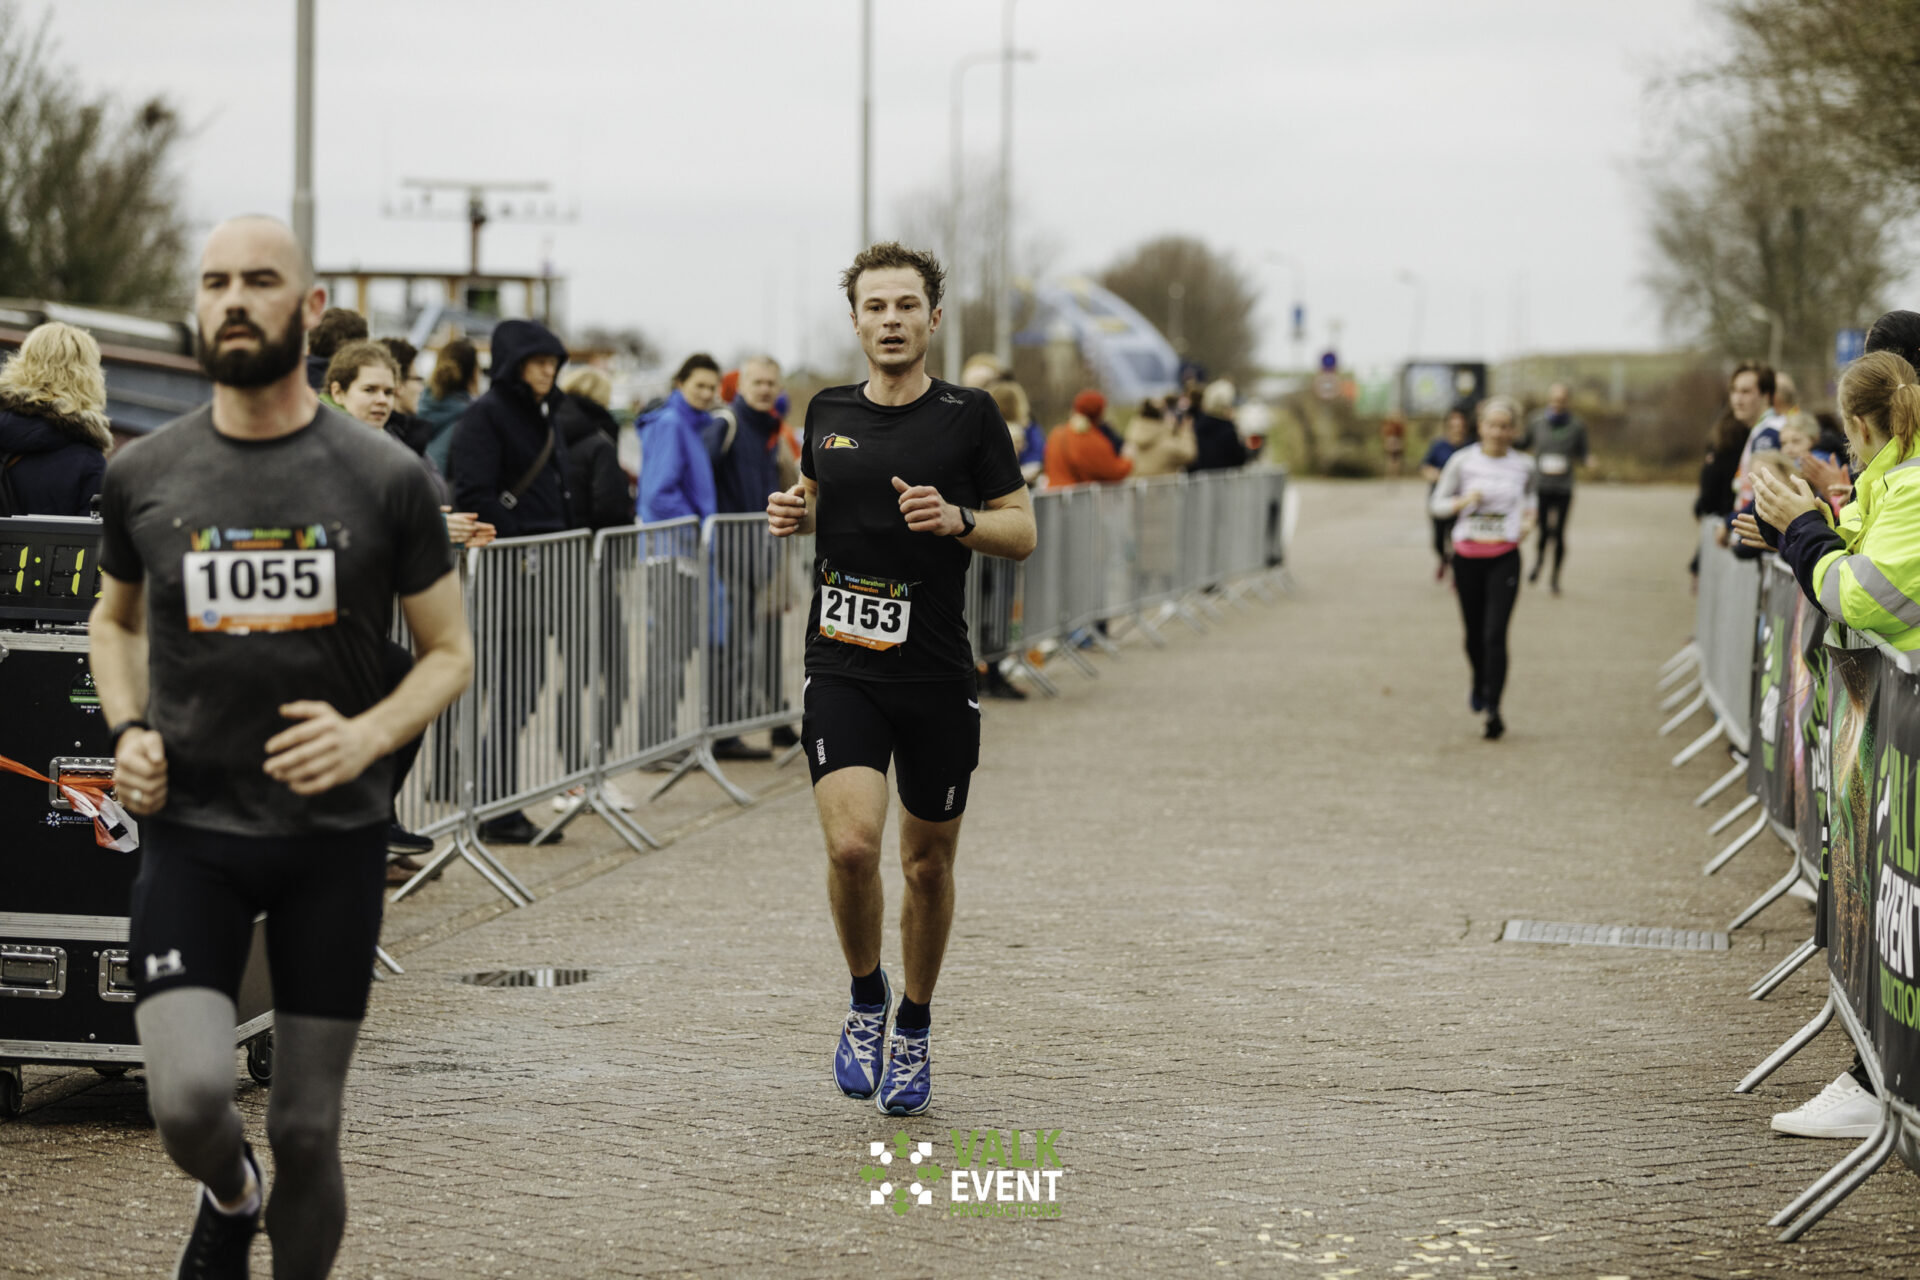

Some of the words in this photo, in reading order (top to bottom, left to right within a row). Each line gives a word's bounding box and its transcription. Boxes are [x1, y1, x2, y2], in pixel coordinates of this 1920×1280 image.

[199, 559, 320, 600] 1055
[860, 578, 885, 589] Marathon
[825, 589, 902, 634] 2153
[816, 738, 827, 766] FUSION
